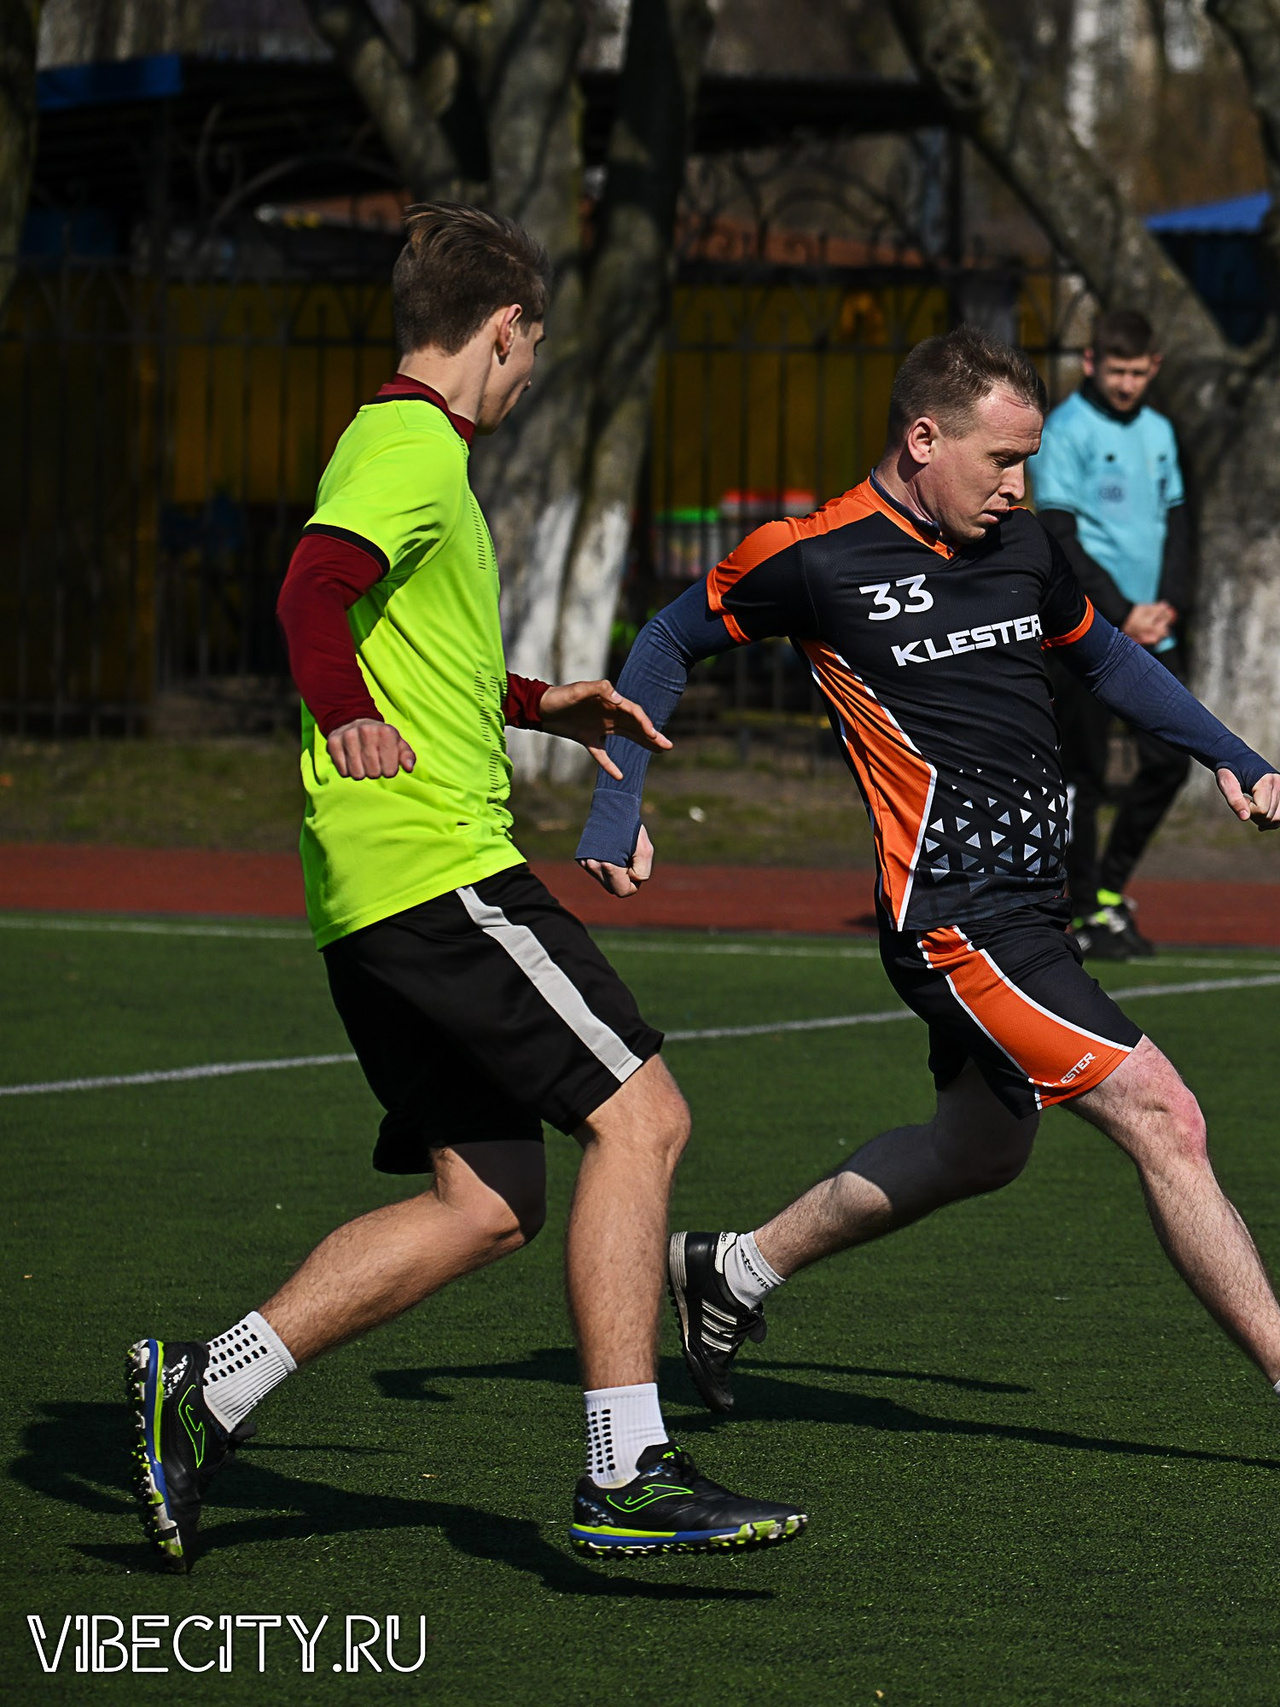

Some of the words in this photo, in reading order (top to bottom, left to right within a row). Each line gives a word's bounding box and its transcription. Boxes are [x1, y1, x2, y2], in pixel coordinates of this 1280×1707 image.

[859, 574, 934, 621] 33
[891, 614, 1043, 667] KLESTER
[1055, 1052, 1096, 1086] ESTER
